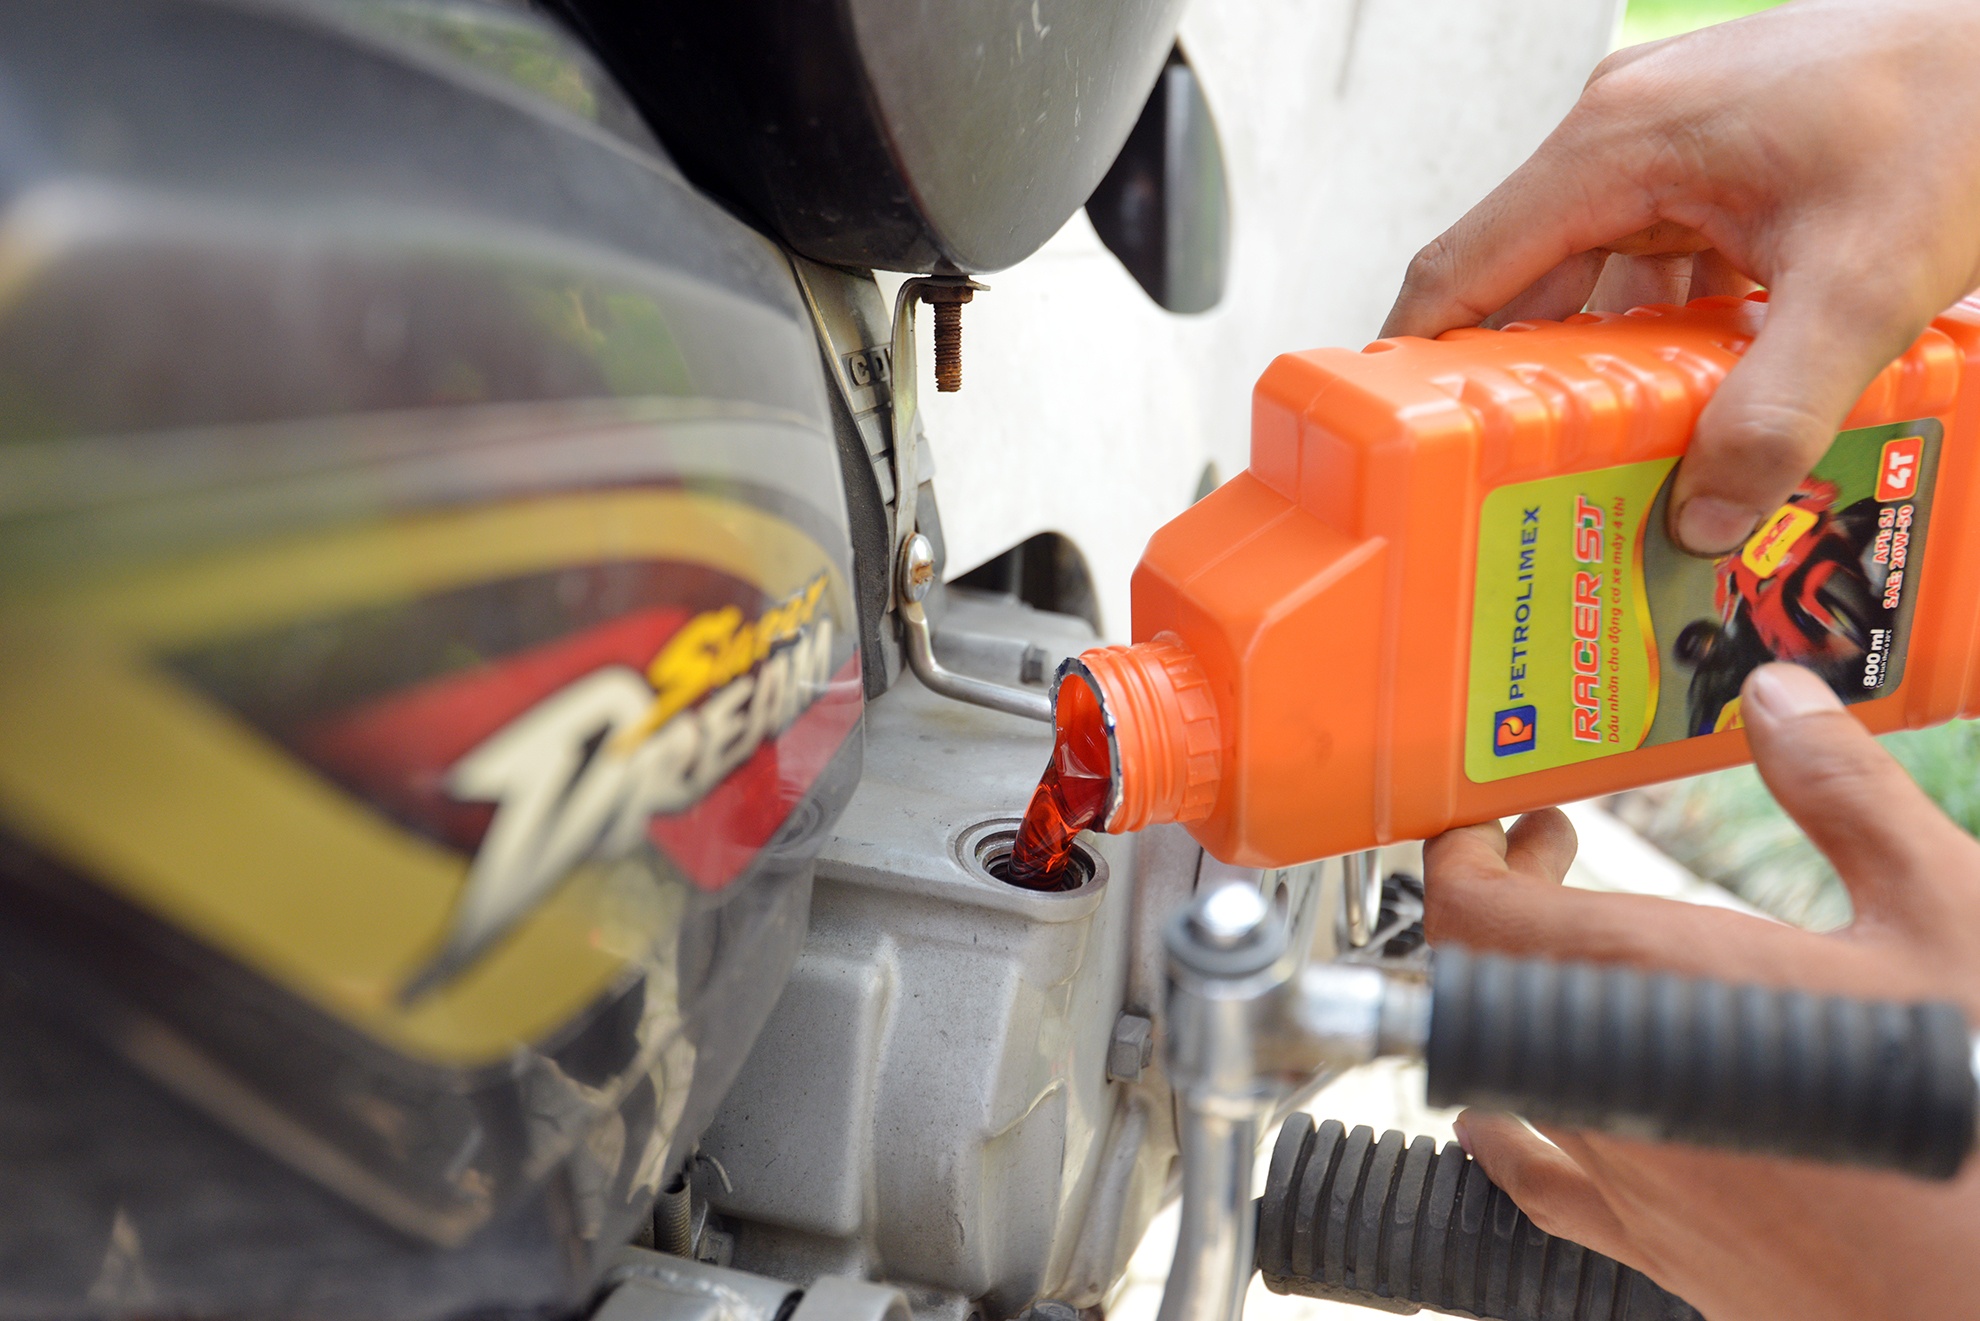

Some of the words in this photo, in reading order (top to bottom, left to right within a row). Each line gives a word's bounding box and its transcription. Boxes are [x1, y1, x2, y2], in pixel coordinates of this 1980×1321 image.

[1887, 452, 1914, 489] 4T
[1574, 495, 1605, 564] SJ
[1612, 520, 1624, 530] 4
[1878, 507, 1896, 529] SJ
[1873, 528, 1893, 564] API:
[1889, 504, 1914, 570] 20W-50
[1612, 568, 1623, 585] xe
[1883, 570, 1903, 610] SAE:
[1509, 505, 1540, 701] PETROLIMEX
[1608, 607, 1624, 644] động
[1870, 629, 1885, 651] ml
[1573, 570, 1603, 743] RACER
[1607, 647, 1620, 673] cho
[1863, 652, 1881, 687] 800
